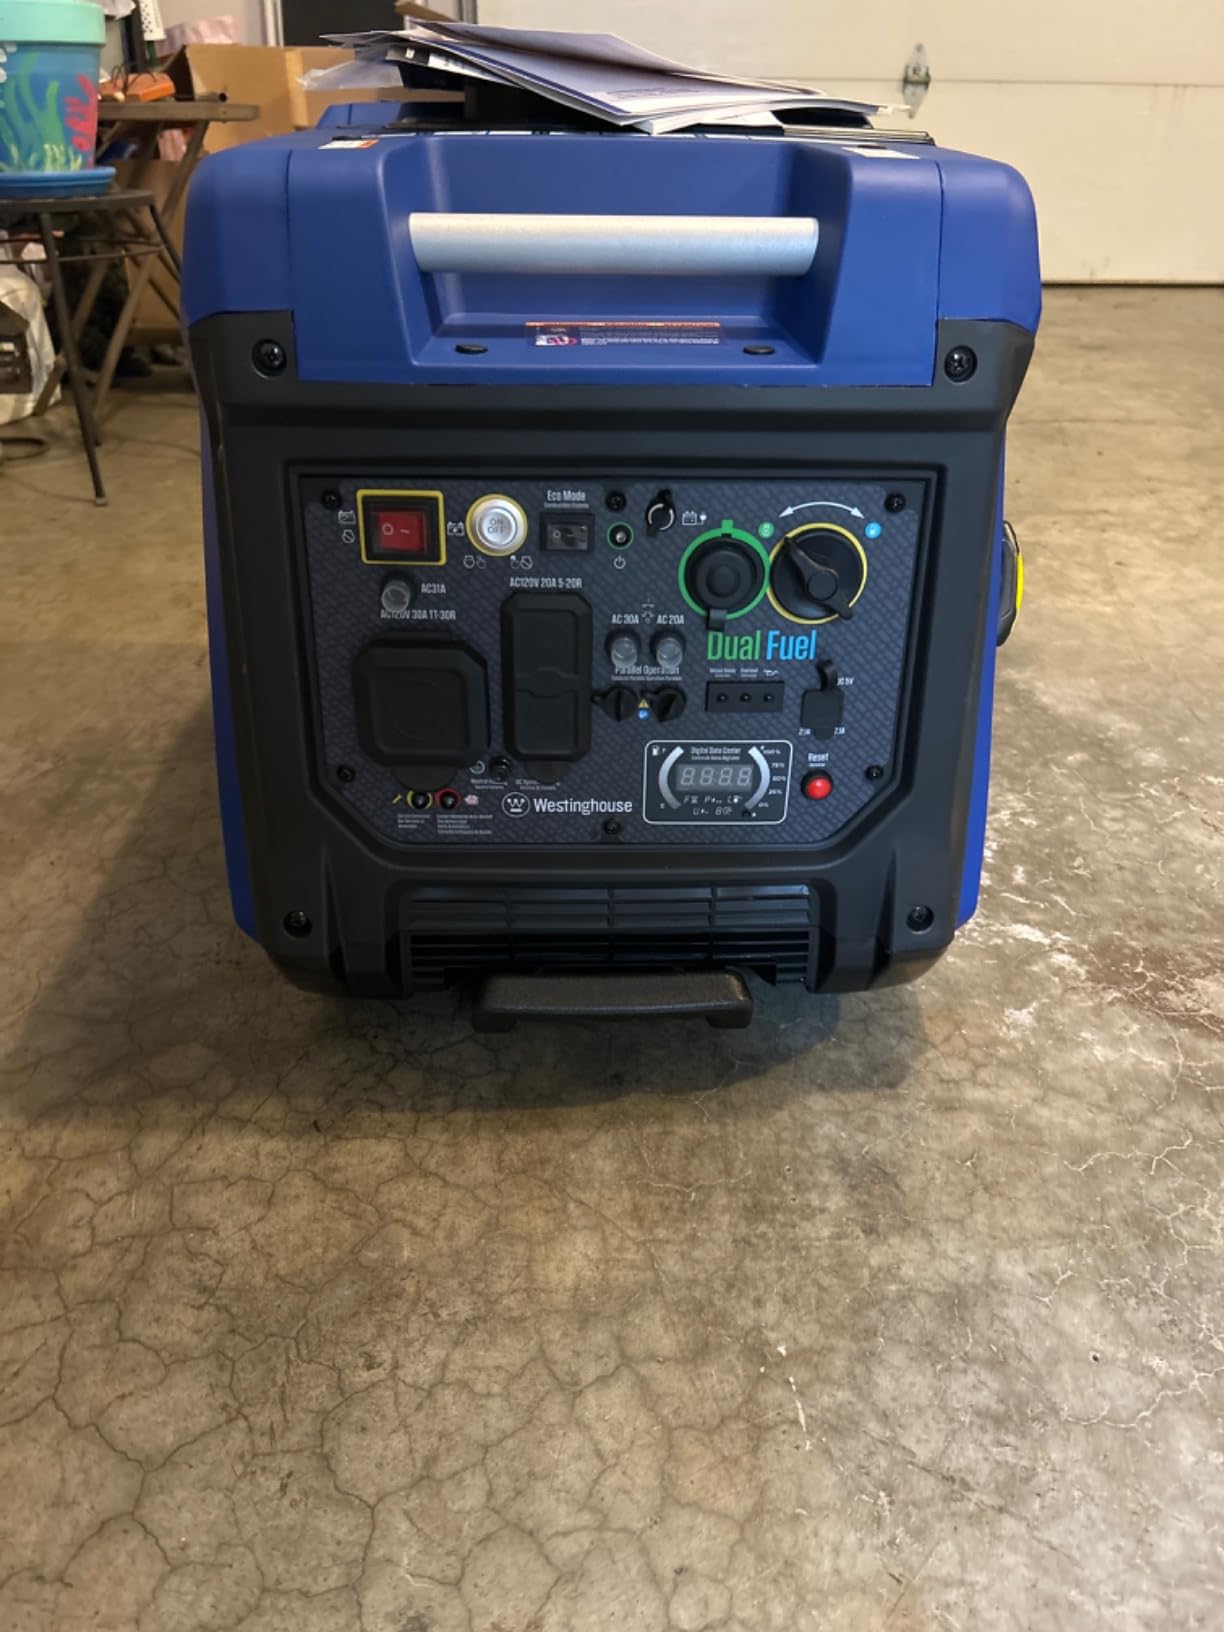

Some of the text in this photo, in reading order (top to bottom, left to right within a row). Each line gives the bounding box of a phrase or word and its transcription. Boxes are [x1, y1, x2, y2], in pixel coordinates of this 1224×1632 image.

[547, 490, 586, 502] Eco Mode
[421, 583, 447, 595] AC31A
[510, 577, 583, 589] AC120V 20A 5-20R
[412, 609, 428, 620] 30A
[611, 614, 640, 625] AC 30A
[657, 614, 685, 625] AC 20A
[707, 629, 818, 661] Dual Fuel
[808, 752, 829, 761] Reset
[533, 798, 633, 816] Westinghouse
